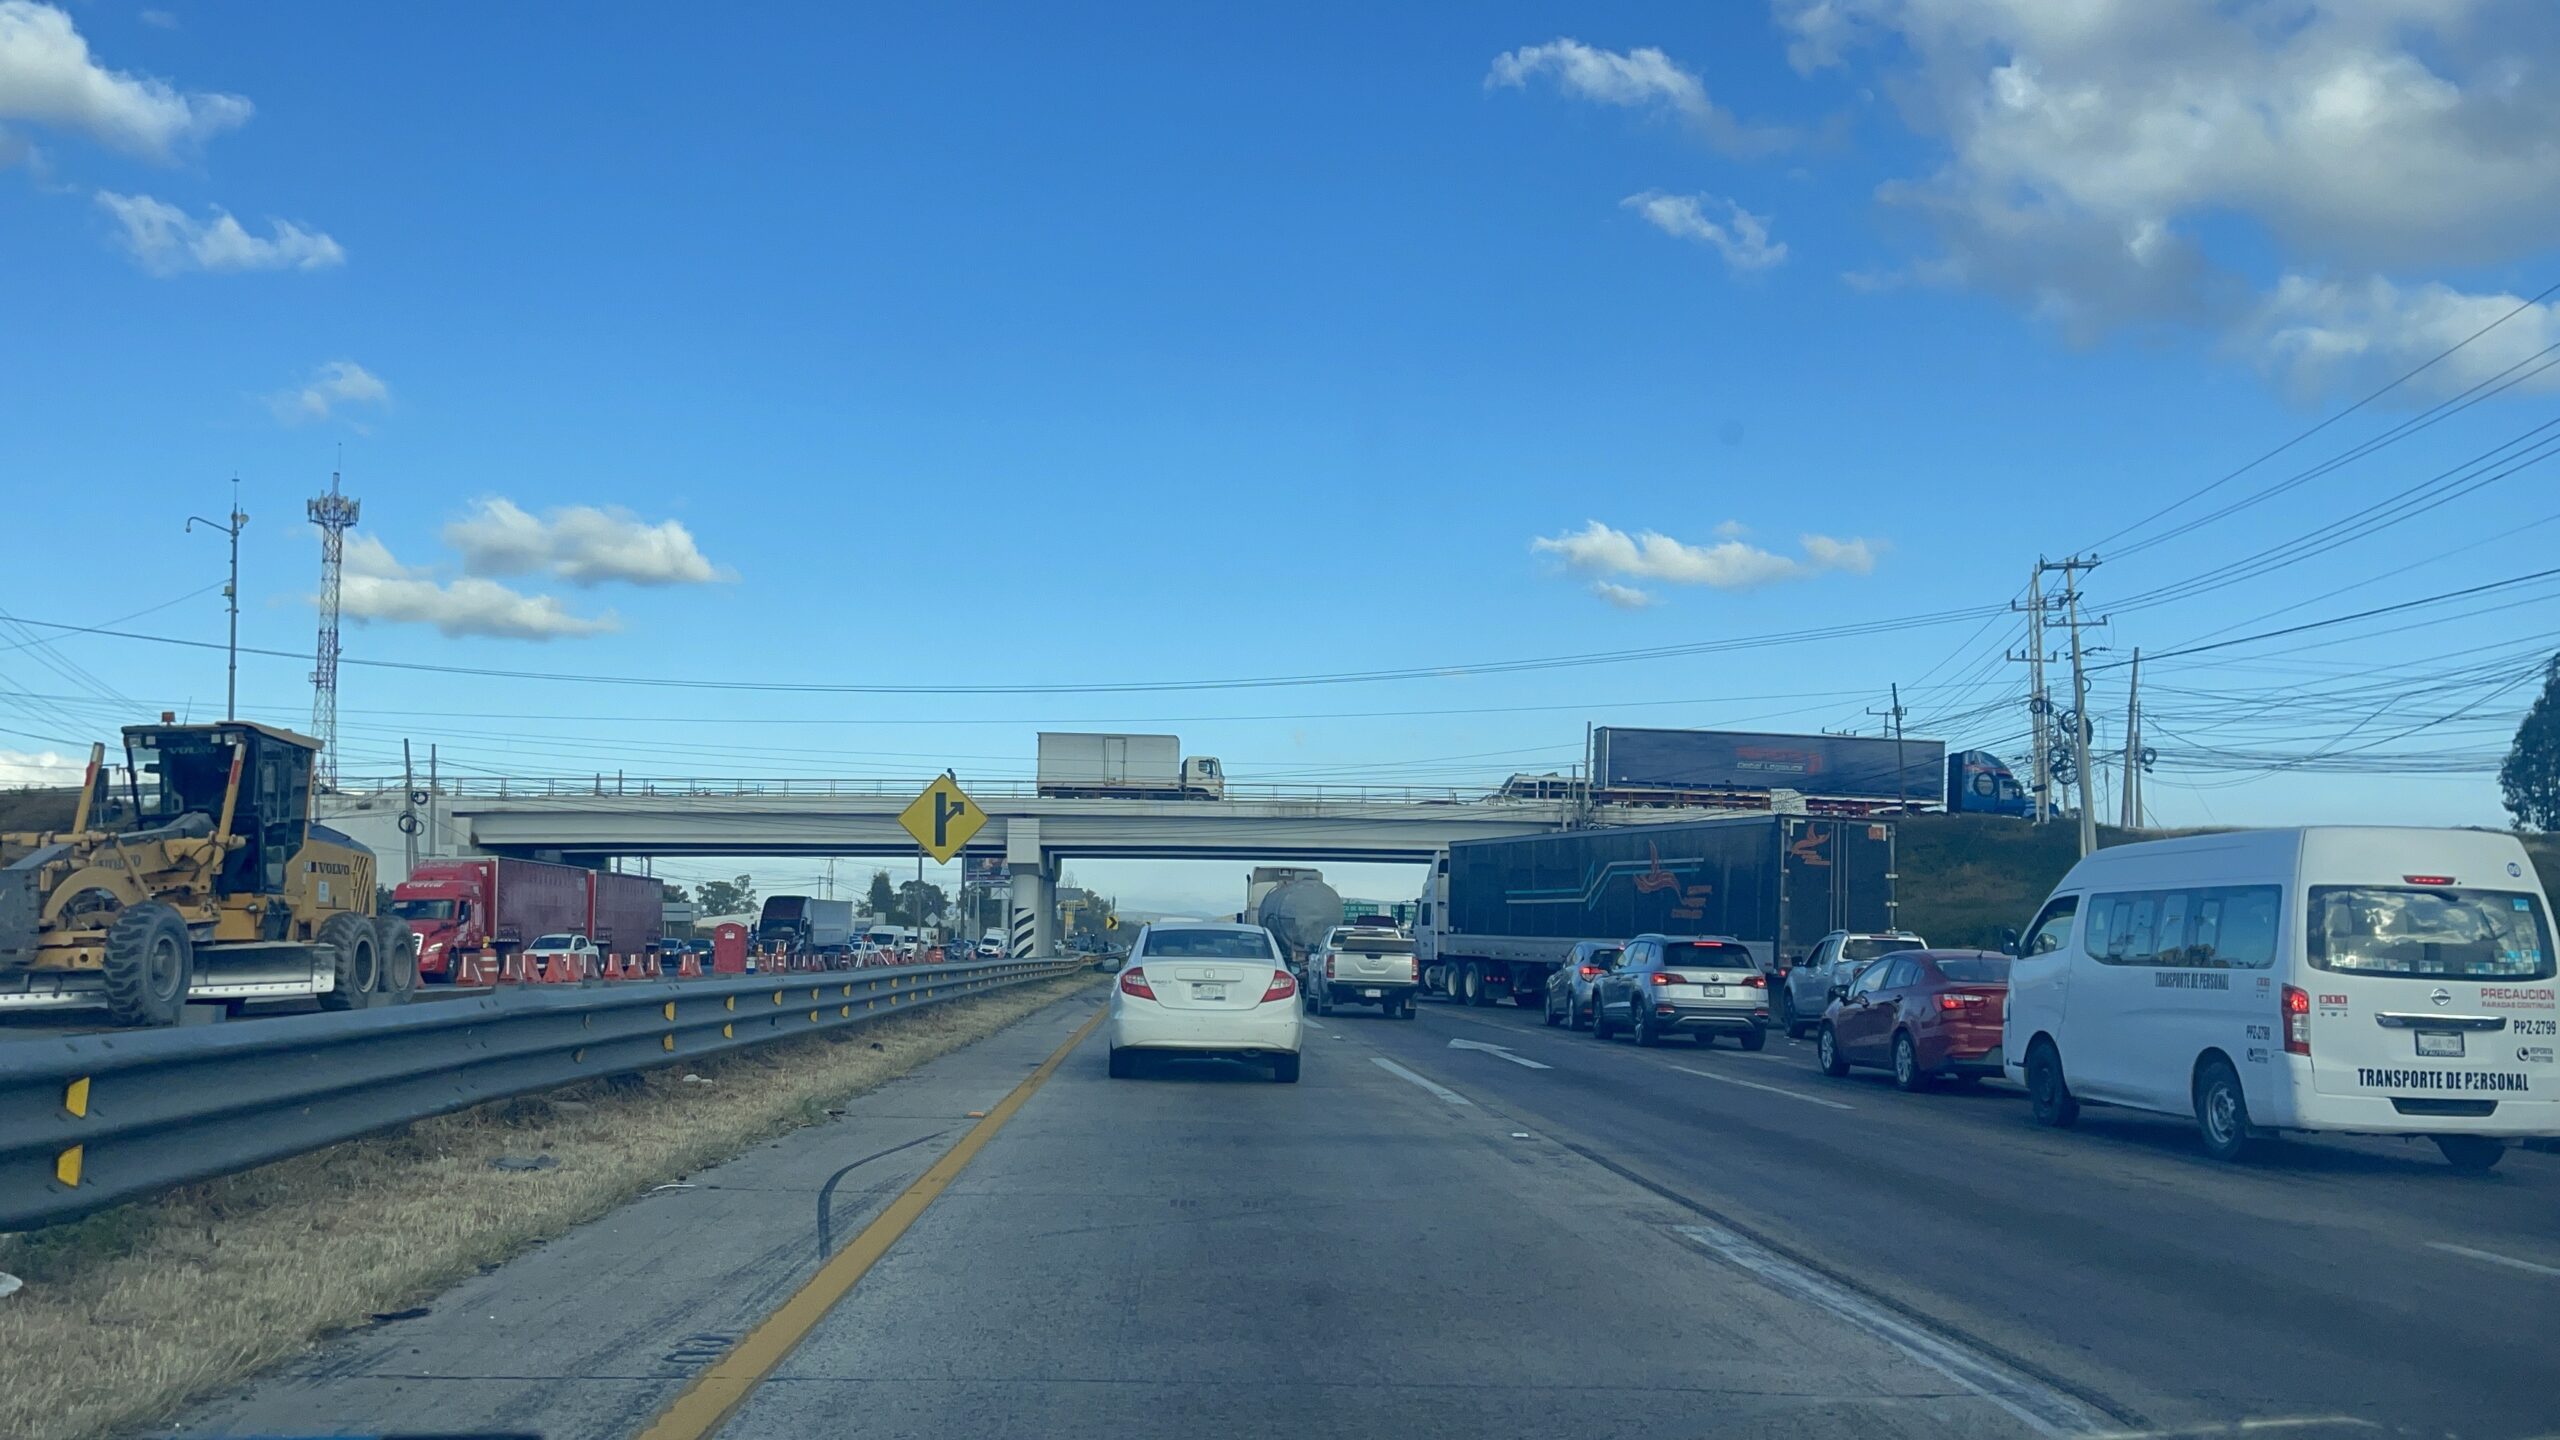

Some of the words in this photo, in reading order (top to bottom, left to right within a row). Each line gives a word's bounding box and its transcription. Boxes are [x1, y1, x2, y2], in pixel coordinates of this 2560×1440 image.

[318, 861, 350, 876] VOLVO
[2481, 988, 2555, 1000] PRECAUCION
[2482, 1001, 2516, 1009] PARADAS
[2514, 1020, 2556, 1035] PPZ-2799
[2358, 1068, 2443, 1089] TRANSPORTE
[2446, 1070, 2461, 1089] DE
[2465, 1071, 2529, 1091] PERSONAL
